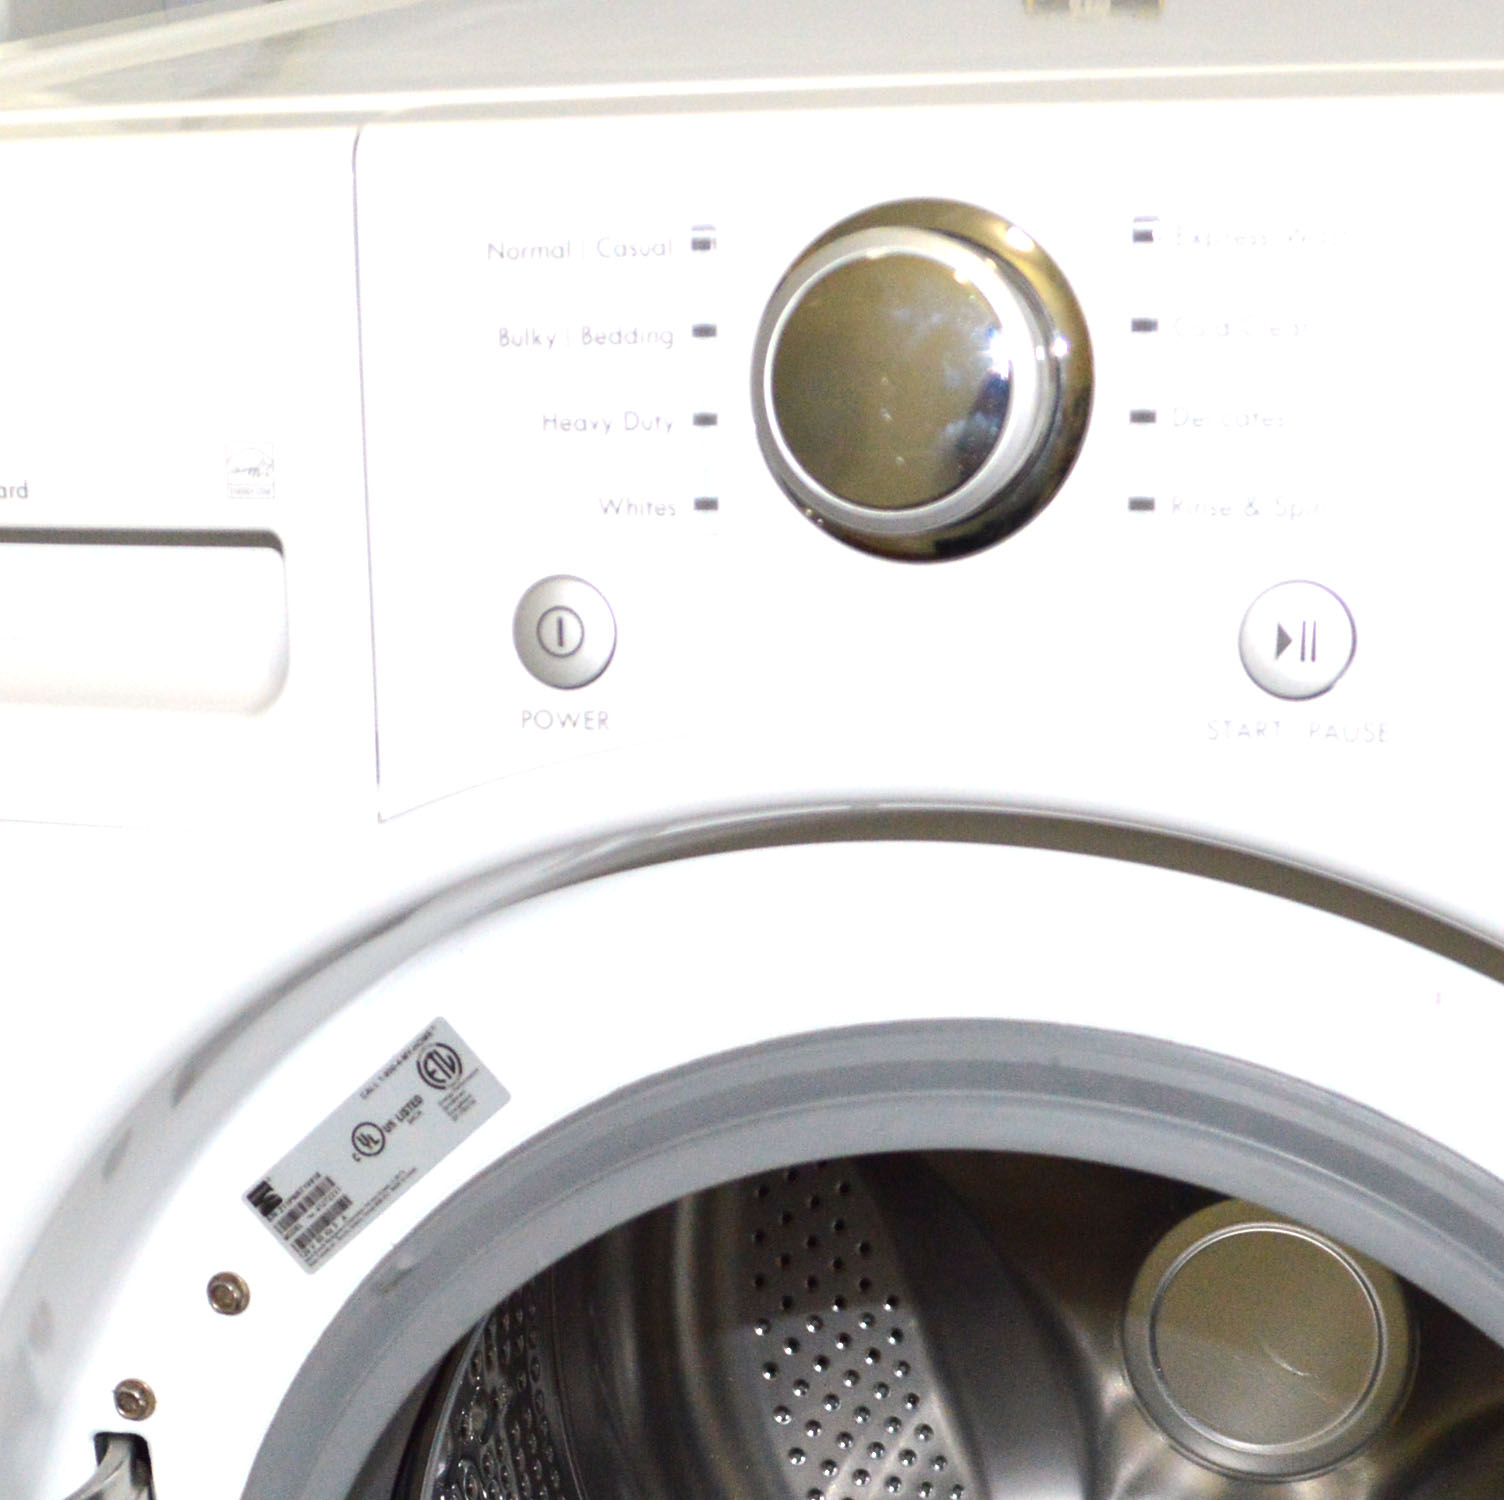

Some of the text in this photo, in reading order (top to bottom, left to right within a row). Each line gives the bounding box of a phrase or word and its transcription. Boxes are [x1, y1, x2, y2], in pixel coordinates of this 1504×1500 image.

[488, 238, 673, 260] Normal Casual
[499, 326, 674, 349] Bulky Bedding
[542, 410, 673, 434] Heavy Duty
[600, 497, 677, 518] Whites
[521, 708, 611, 731] POWER
[1207, 719, 1389, 743] START PAUSE
[395, 1094, 424, 1122] LISTED
[356, 1132, 380, 1149] UL
